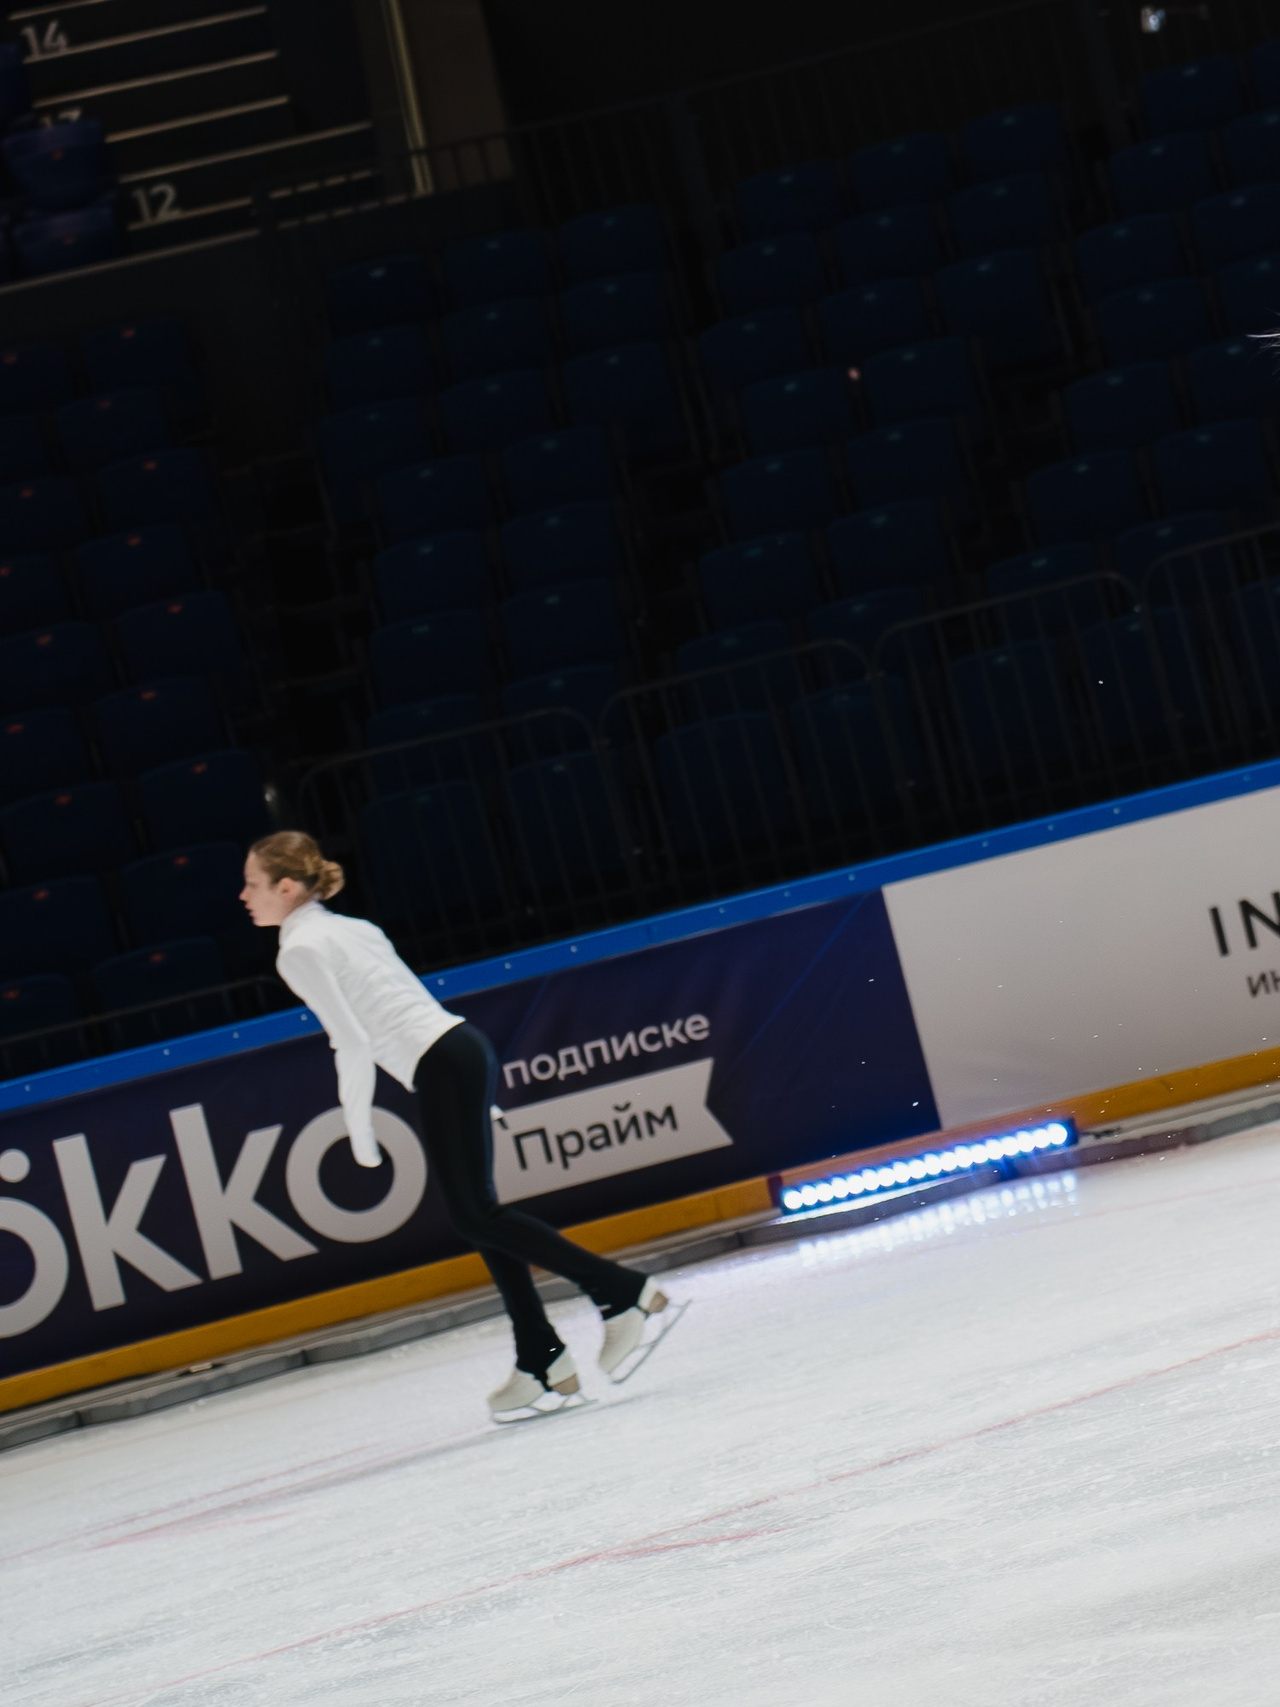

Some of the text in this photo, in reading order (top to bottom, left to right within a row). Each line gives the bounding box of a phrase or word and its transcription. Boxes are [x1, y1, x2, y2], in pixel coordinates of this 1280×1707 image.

[21, 19, 69, 58] 14
[132, 182, 181, 223] 12
[503, 1014, 711, 1089] подписке
[514, 1102, 678, 1171] Прайм
